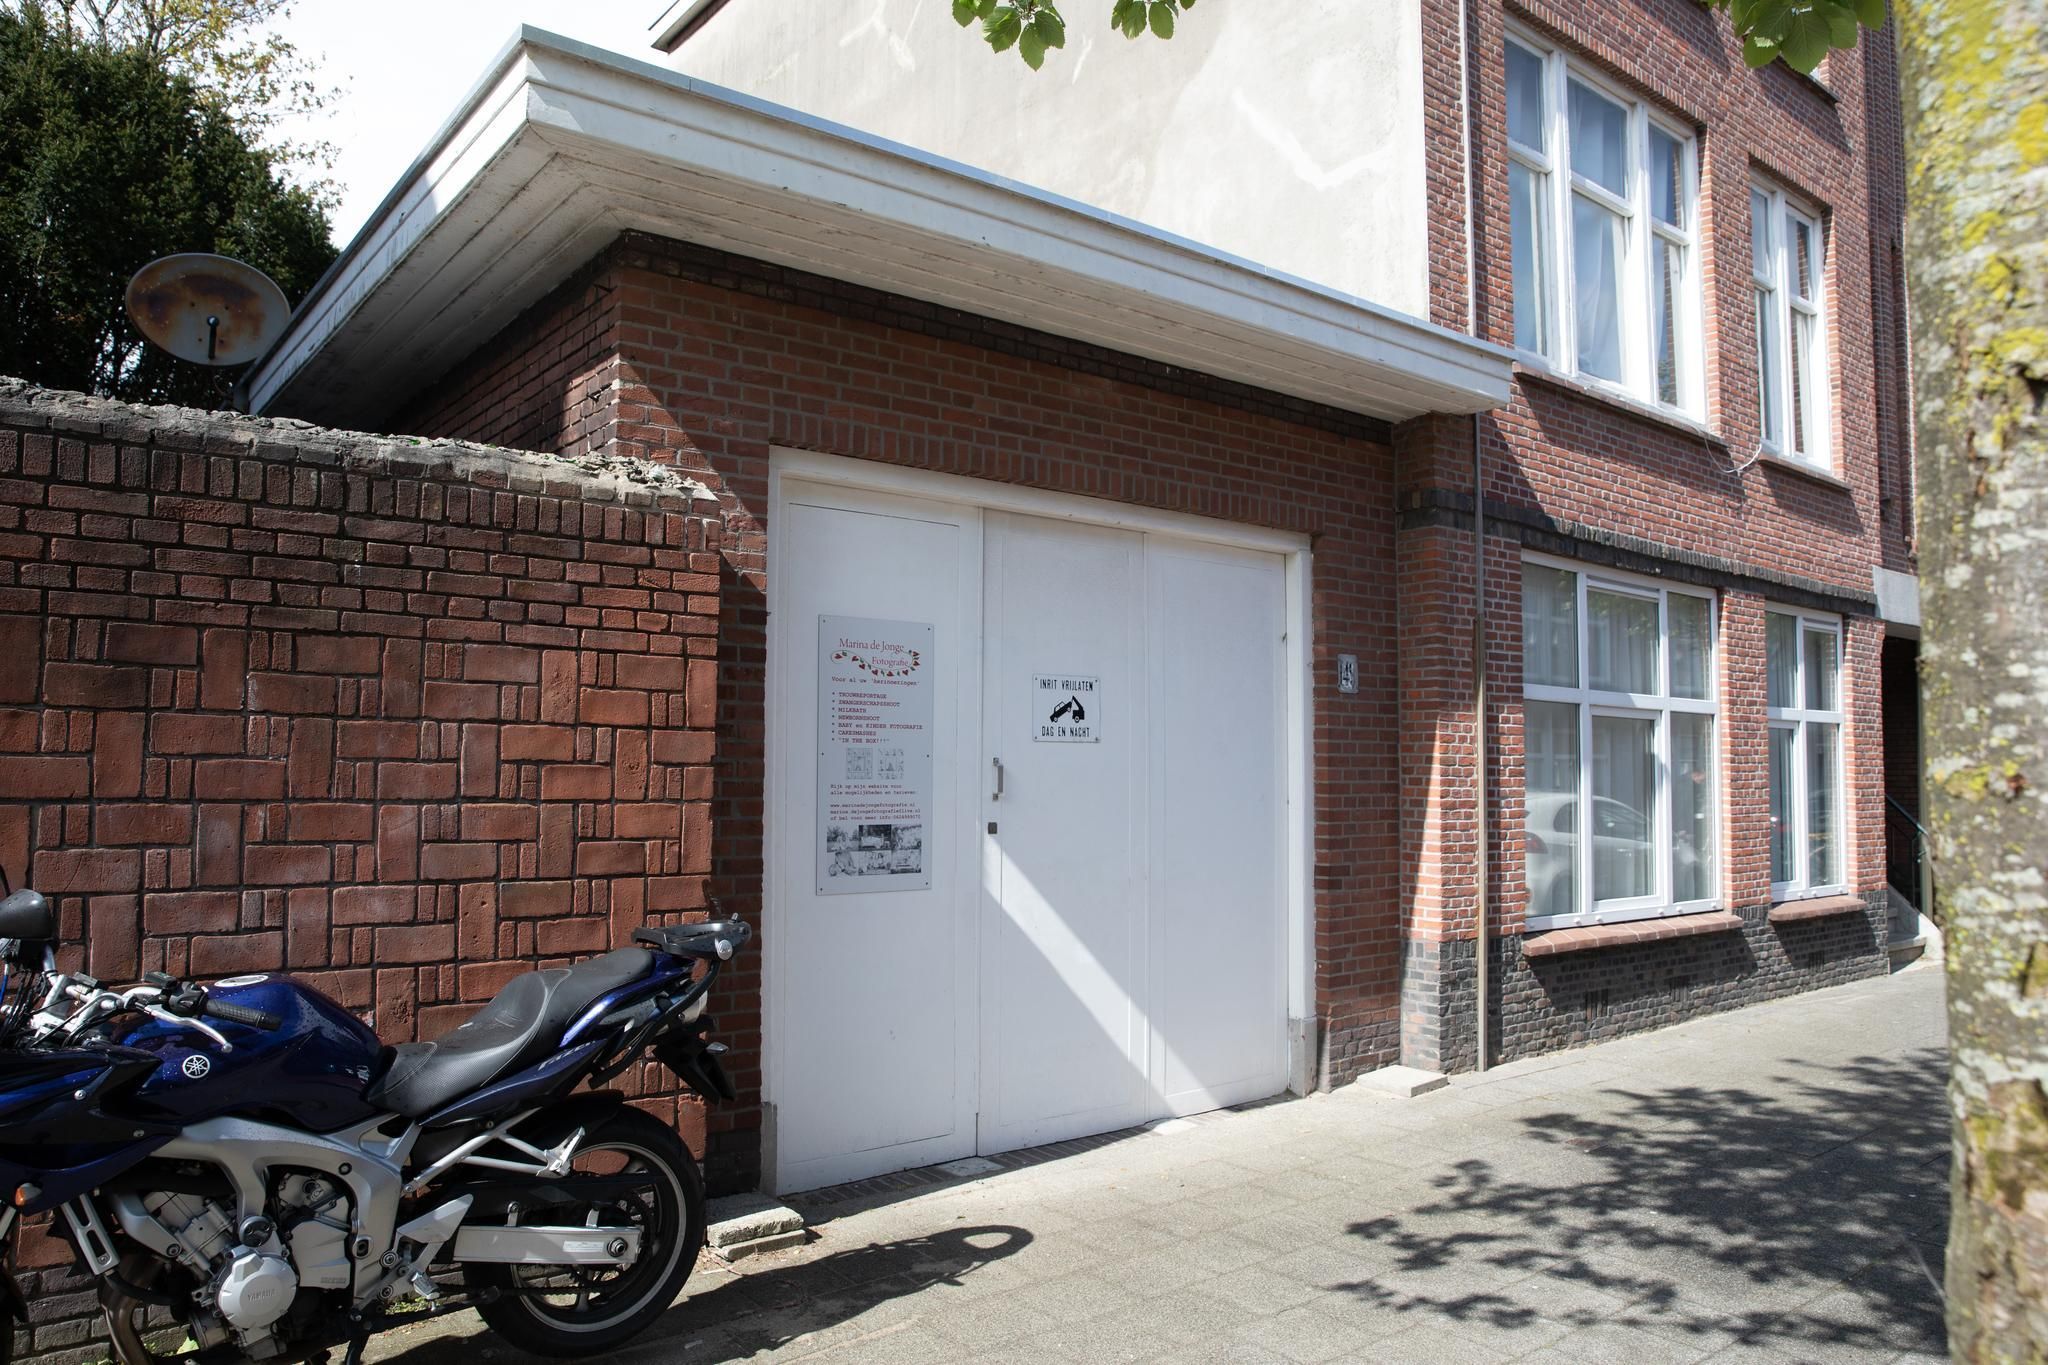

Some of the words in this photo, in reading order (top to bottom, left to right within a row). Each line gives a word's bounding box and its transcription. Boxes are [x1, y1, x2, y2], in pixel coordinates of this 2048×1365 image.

[839, 638, 869, 650] Marina
[870, 639, 881, 650] de
[881, 640, 905, 654] Jonge
[872, 656, 909, 668] Fotografie
[1040, 679, 1057, 690] INRIT
[1061, 680, 1093, 691] VRIJLATEN
[1041, 725, 1054, 737] DAG
[1057, 726, 1066, 737] EN
[1069, 727, 1090, 738] NACHT
